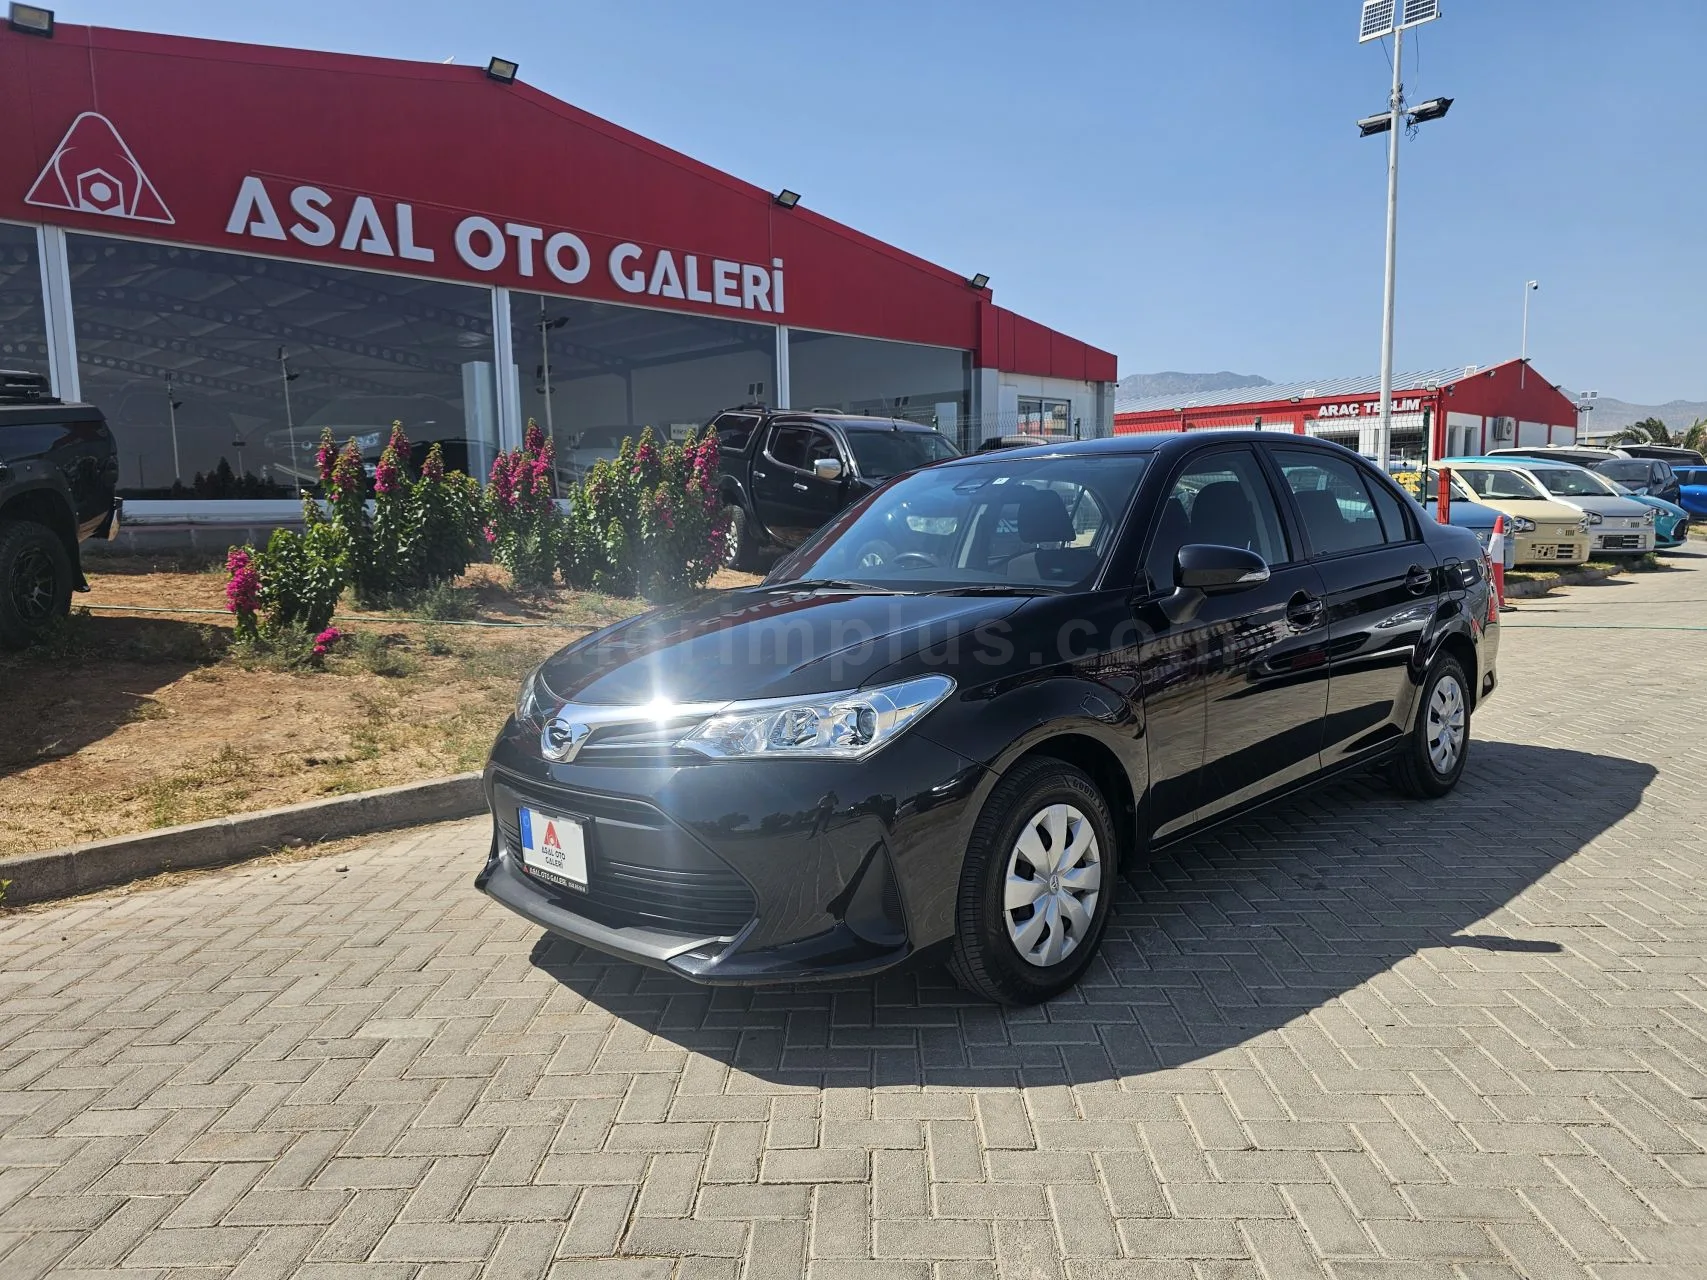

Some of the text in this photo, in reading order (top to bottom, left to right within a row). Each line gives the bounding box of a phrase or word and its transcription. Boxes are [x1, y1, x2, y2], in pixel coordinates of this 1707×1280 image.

[225, 175, 785, 314] ASAL OTO GALERİ
[1318, 397, 1422, 417] ARAÇ TELİM
